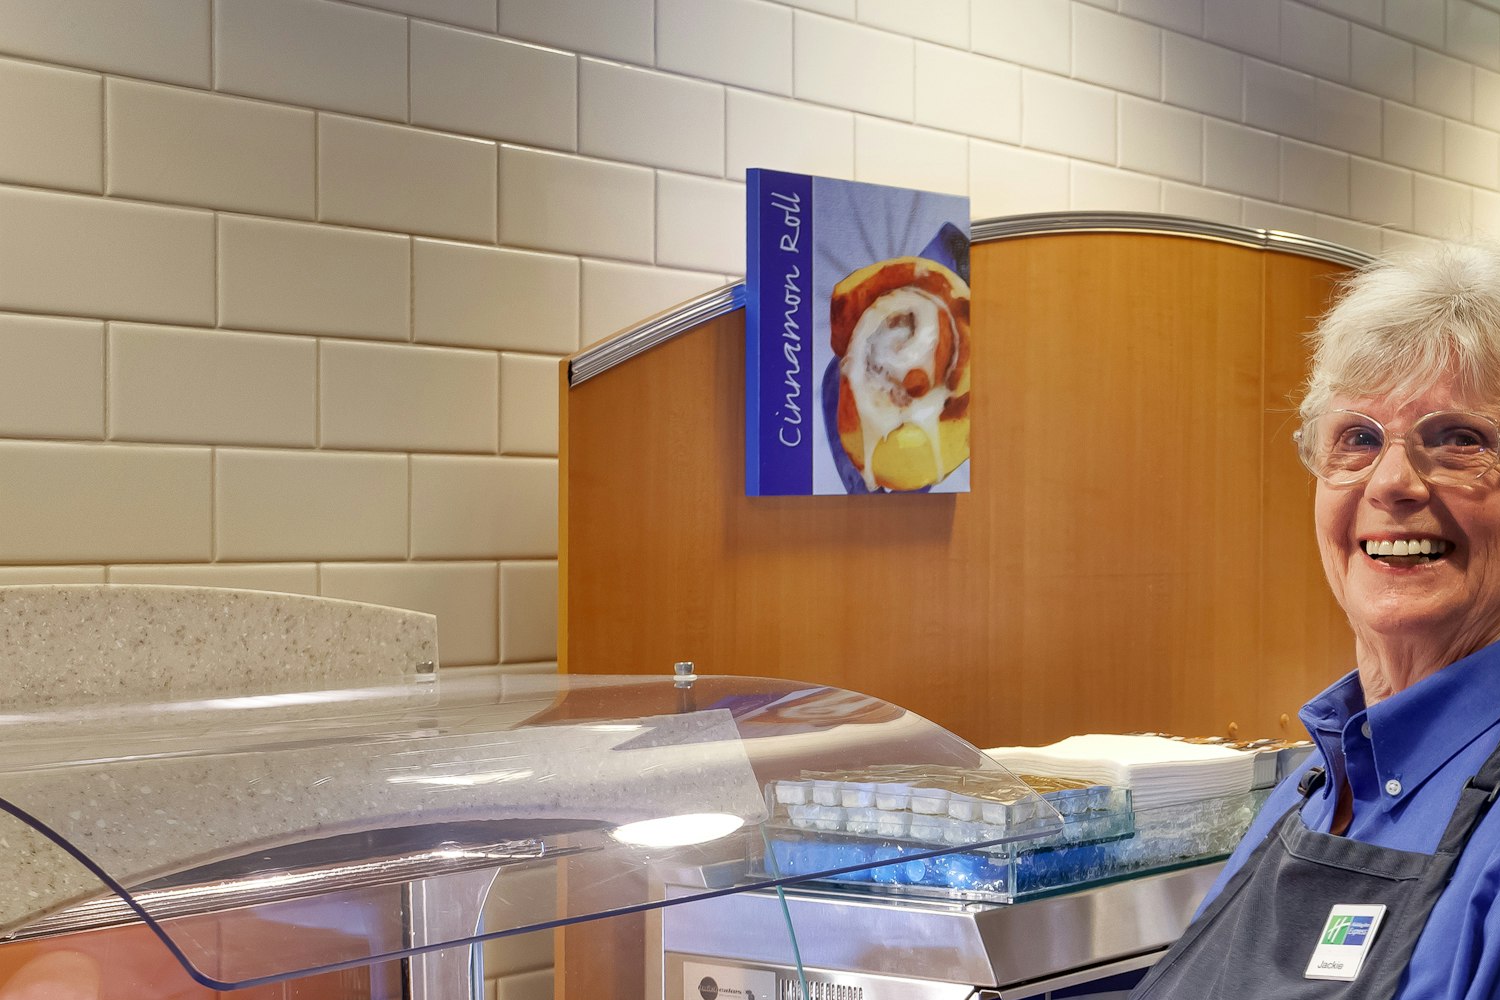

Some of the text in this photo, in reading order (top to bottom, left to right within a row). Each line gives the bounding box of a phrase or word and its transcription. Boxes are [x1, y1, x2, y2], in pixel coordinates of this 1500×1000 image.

[771, 192, 801, 447] Cinnamon Roll
[1317, 960, 1344, 969] Jackie
